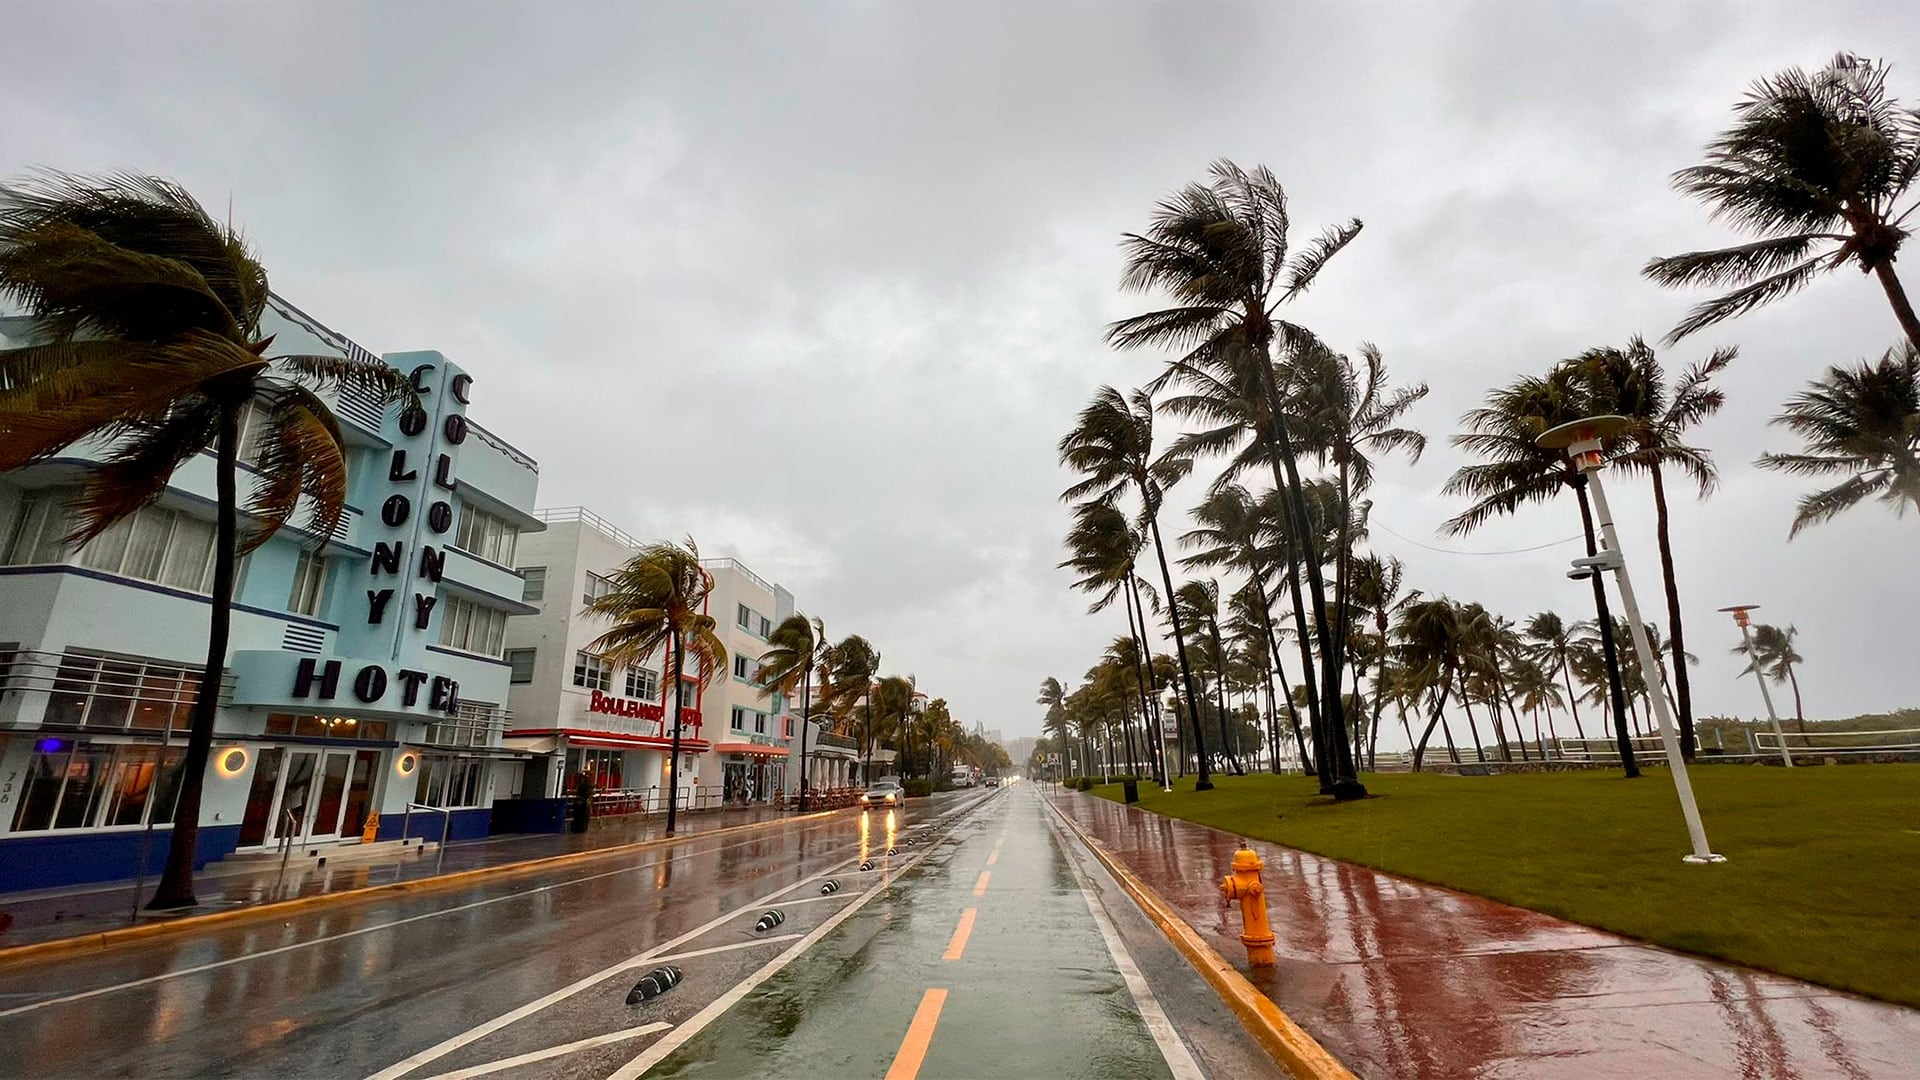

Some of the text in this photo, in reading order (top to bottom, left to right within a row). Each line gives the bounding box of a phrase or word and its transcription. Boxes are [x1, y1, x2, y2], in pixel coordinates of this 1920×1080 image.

[367, 364, 435, 624] COLONY
[414, 373, 474, 630] COLONY
[292, 657, 460, 715] HOTEL
